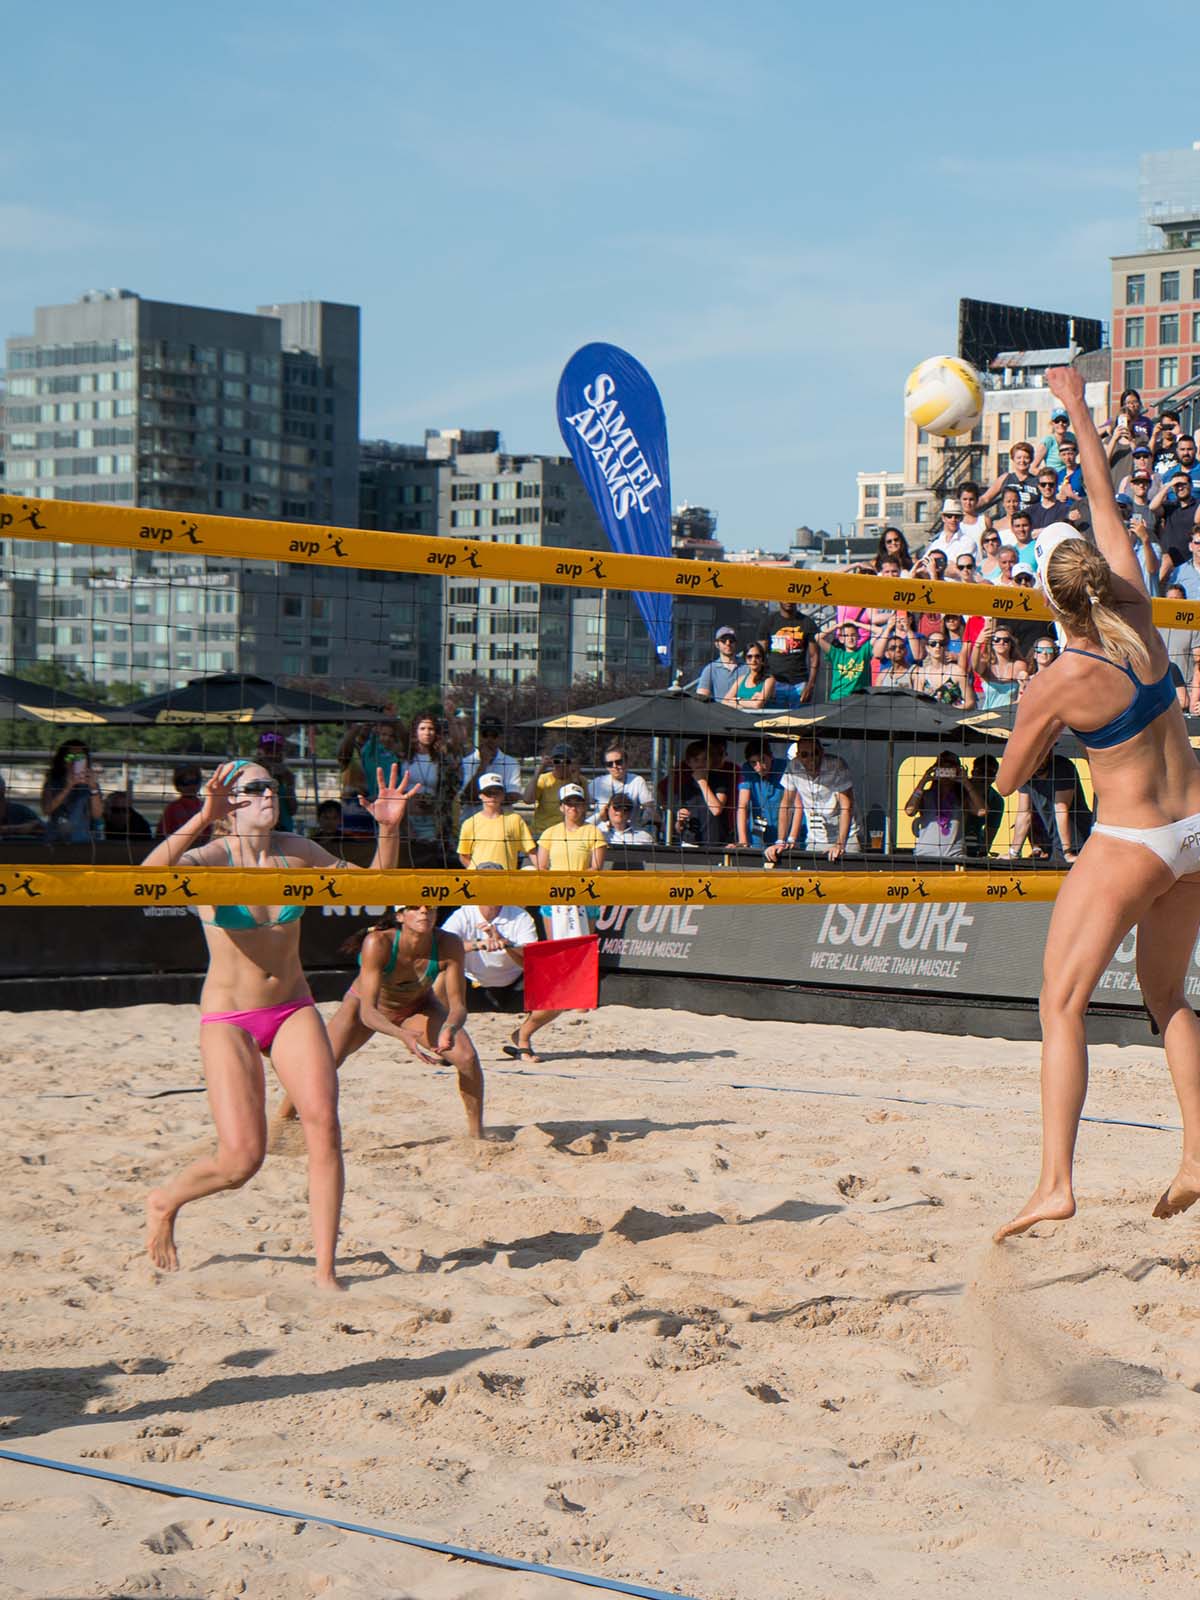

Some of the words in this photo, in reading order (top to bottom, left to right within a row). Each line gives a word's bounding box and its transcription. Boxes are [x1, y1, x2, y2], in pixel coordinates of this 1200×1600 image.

[584, 373, 662, 514] SAMUEL
[565, 407, 637, 520] ADAMS
[140, 526, 174, 545] avp
[288, 540, 321, 557] avp
[426, 552, 457, 569] avp
[555, 563, 583, 580] avp
[675, 573, 701, 589] avp
[787, 583, 812, 598] avp
[893, 591, 916, 605] avp
[992, 597, 1014, 612] avp
[1175, 610, 1195, 625] avp
[134, 883, 168, 901] avp
[283, 883, 314, 901] avp
[421, 885, 450, 901] avp
[549, 886, 576, 902] avp
[669, 886, 695, 901] avp
[781, 885, 805, 901] avp
[887, 885, 910, 900] avp
[986, 884, 1008, 898] avp
[817, 903, 975, 952] ISOPURE
[601, 938, 629, 955] MORE
[629, 940, 652, 957] THAN
[653, 941, 691, 959] MUSCLE
[810, 951, 843, 969] WE'RE
[840, 954, 859, 971] ALL
[860, 954, 891, 973] MORE
[891, 956, 918, 975] THAN
[917, 958, 961, 978] MUSCLE
